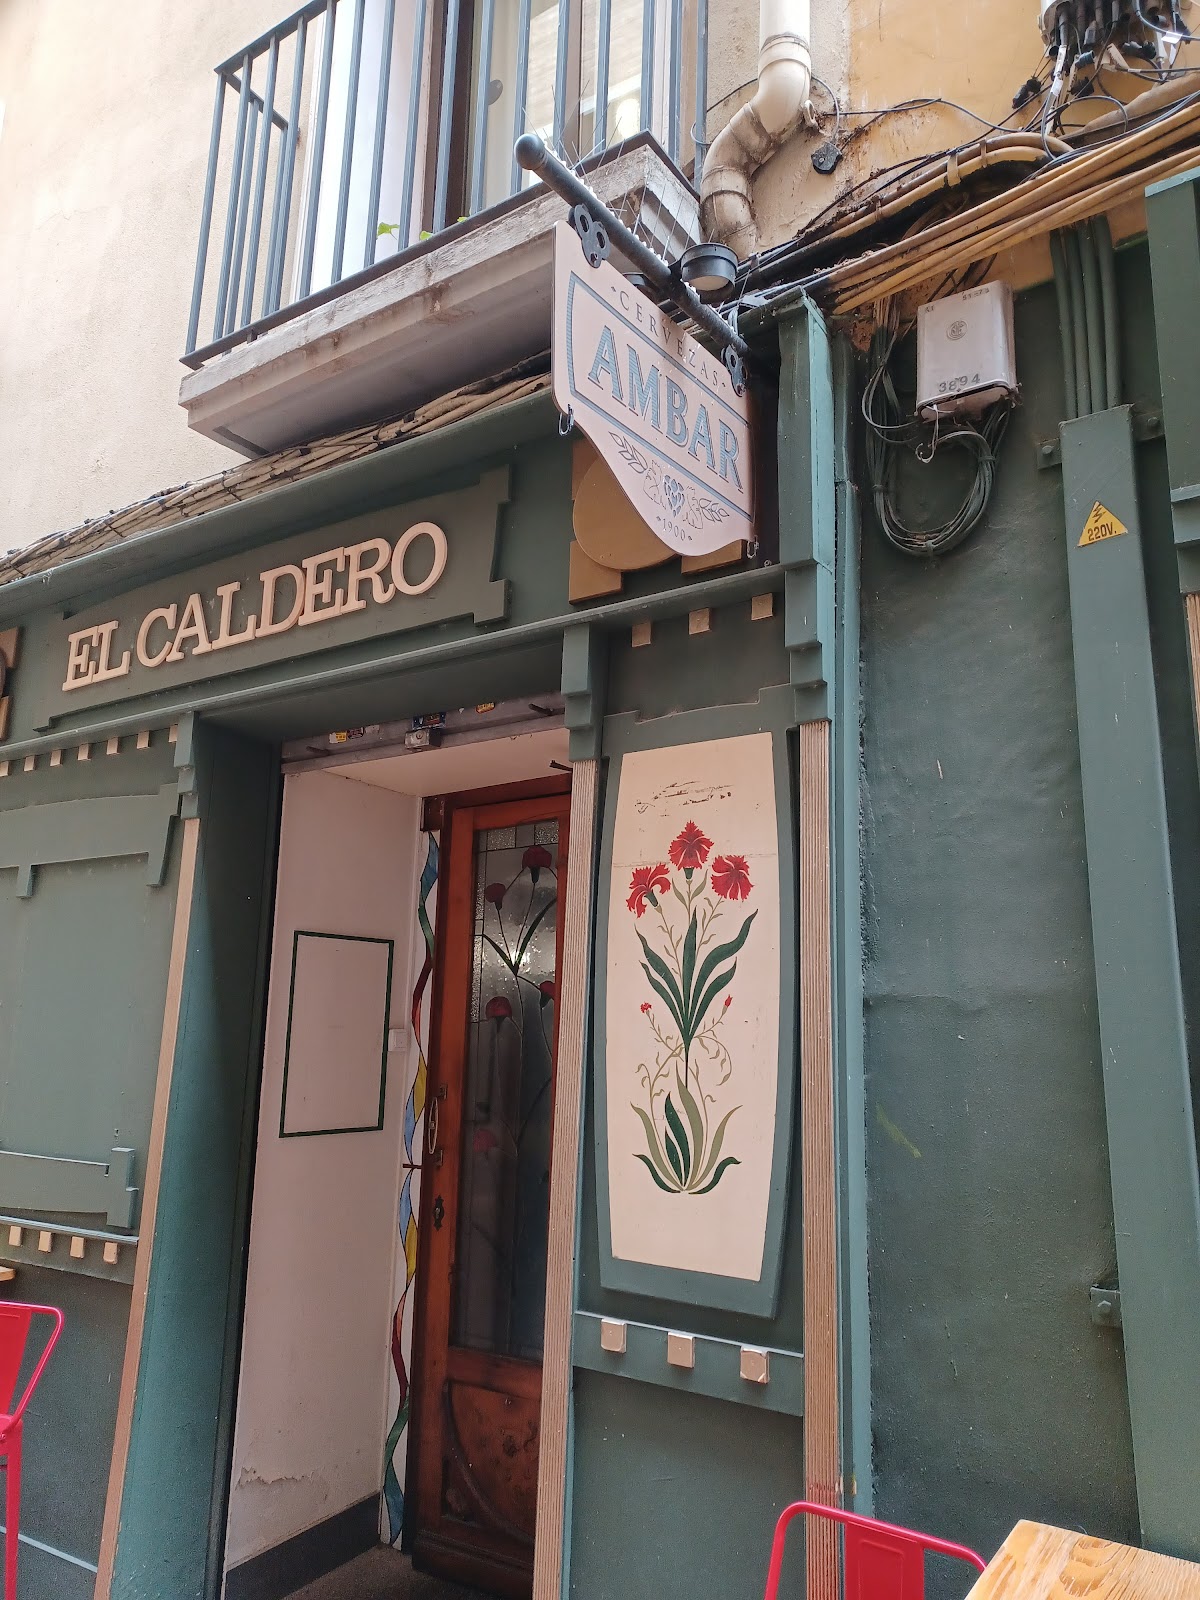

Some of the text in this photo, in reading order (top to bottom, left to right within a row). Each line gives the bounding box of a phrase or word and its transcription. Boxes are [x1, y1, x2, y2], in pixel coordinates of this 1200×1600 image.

[620, 290, 718, 387] CERVEZAS
[938, 373, 981, 393] 3894
[588, 325, 744, 494] AMBAR
[62, 522, 448, 691] EL CALDERO
